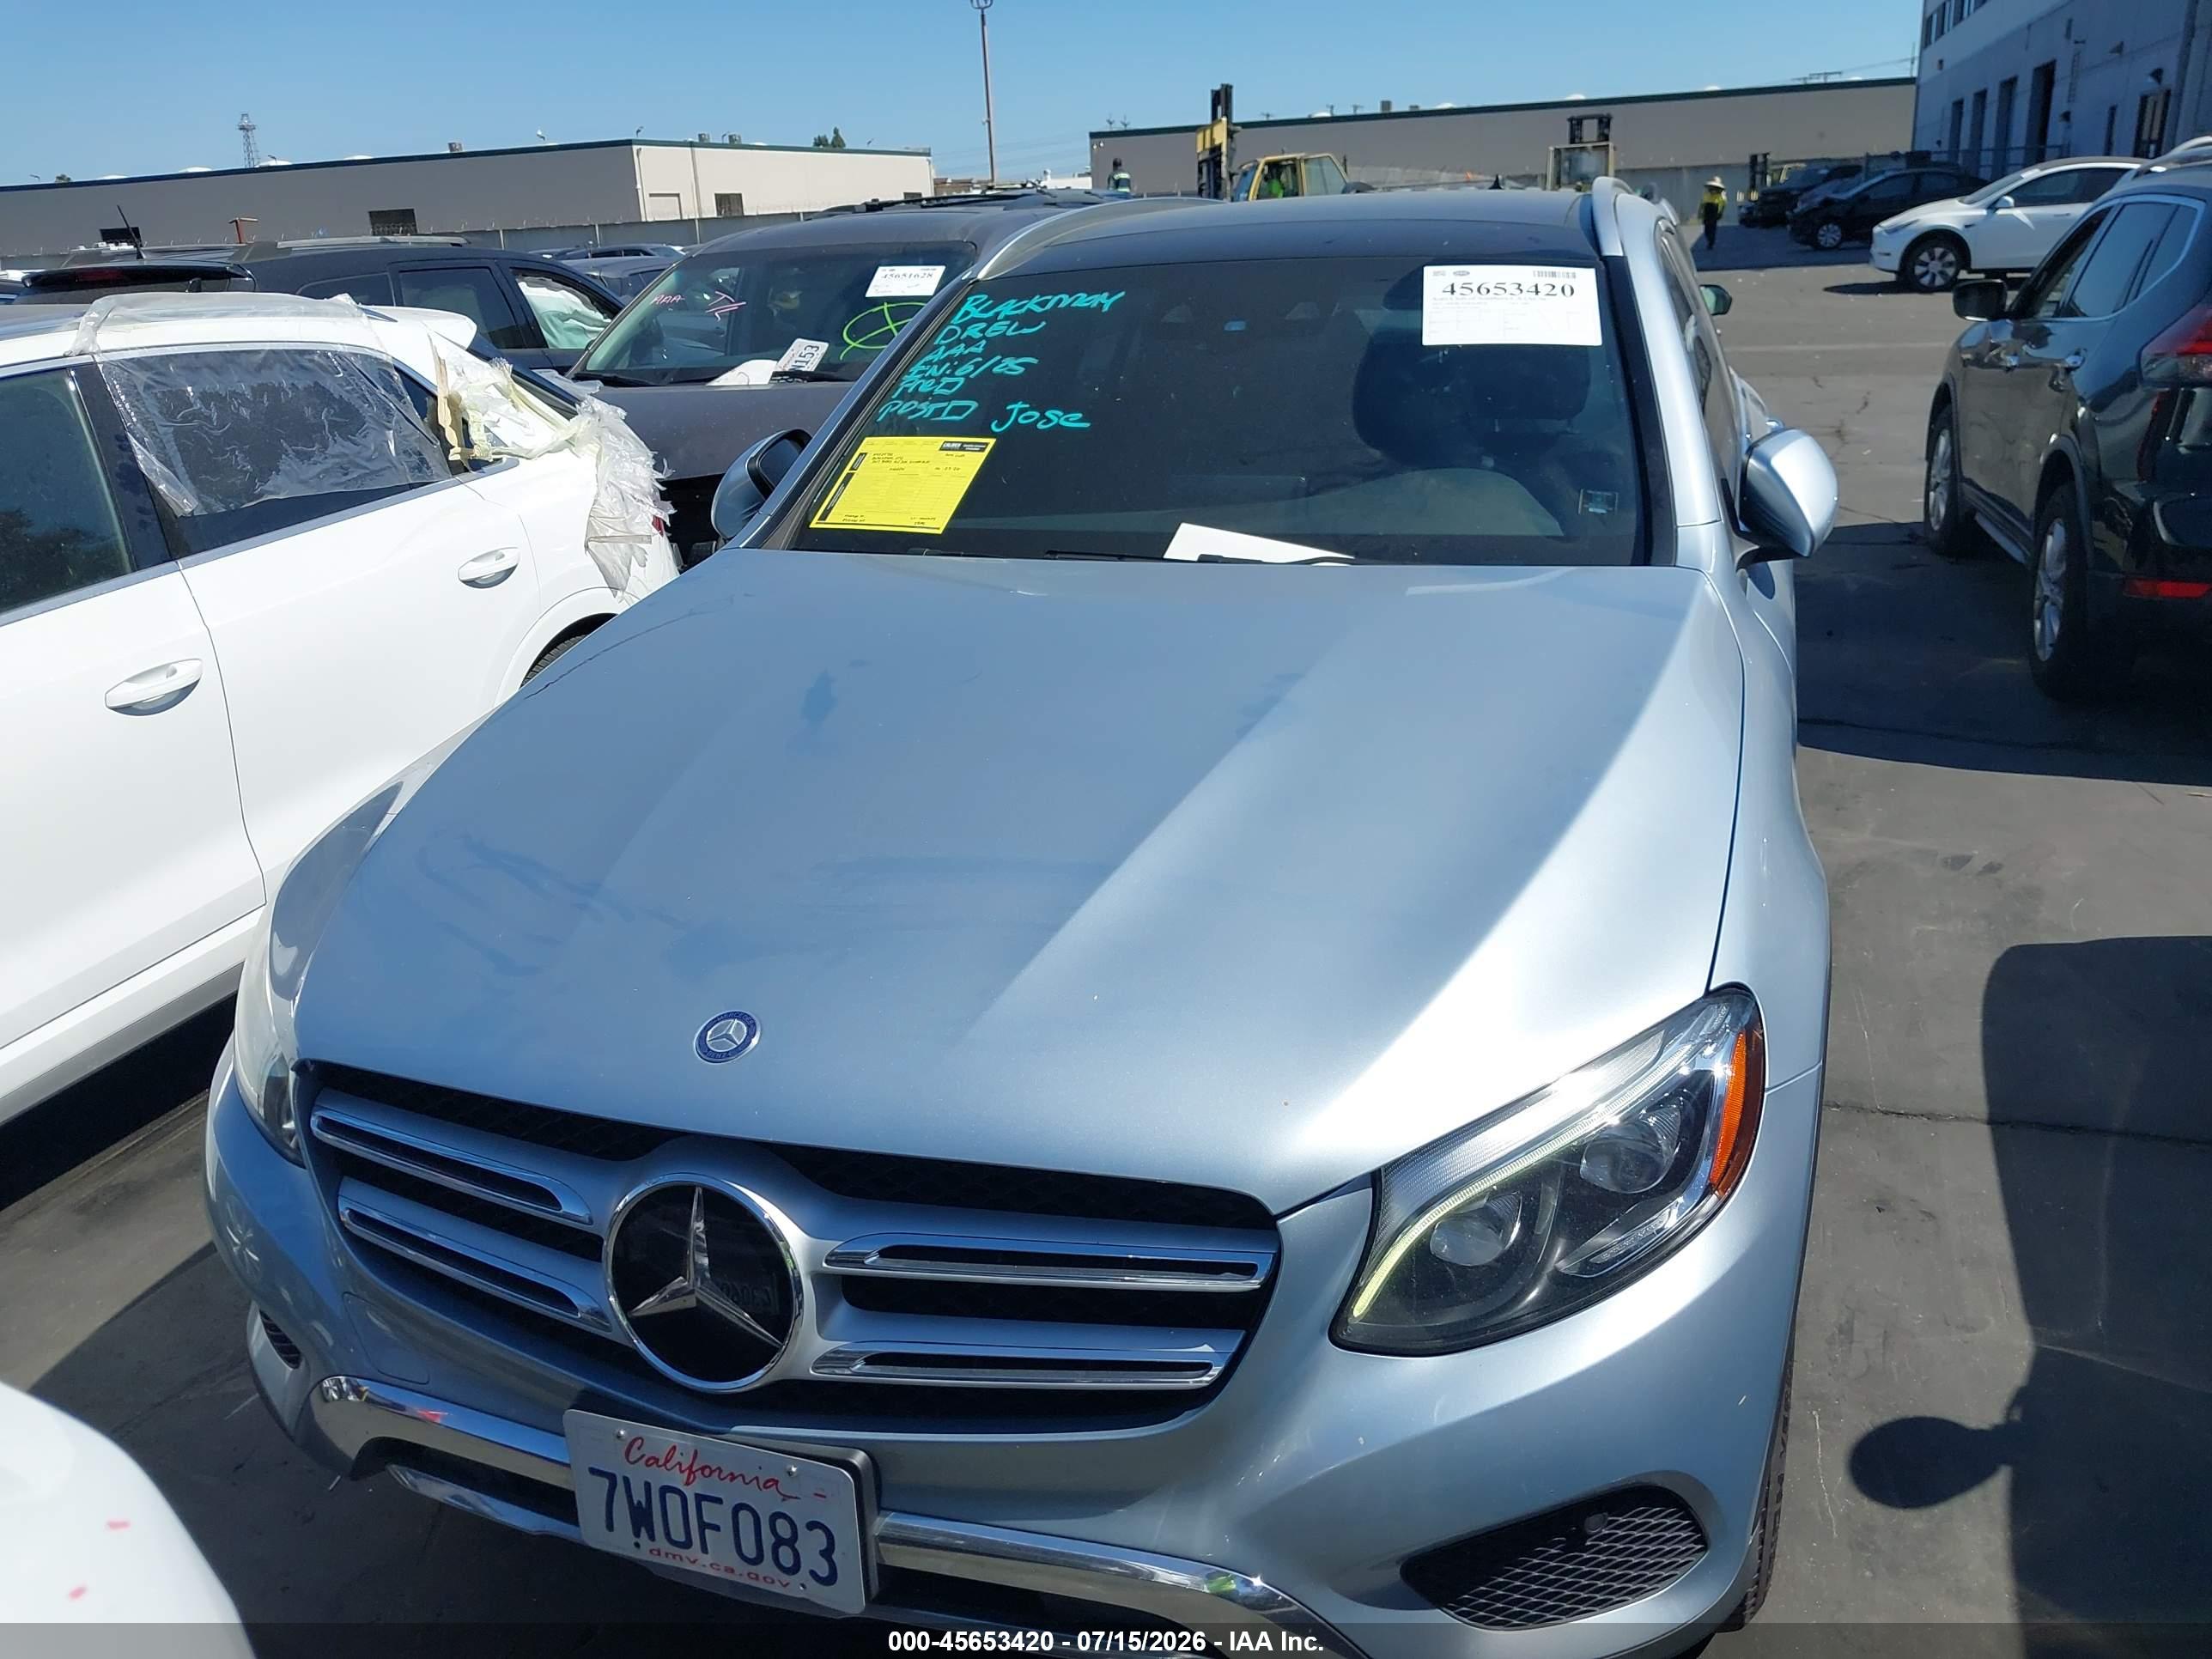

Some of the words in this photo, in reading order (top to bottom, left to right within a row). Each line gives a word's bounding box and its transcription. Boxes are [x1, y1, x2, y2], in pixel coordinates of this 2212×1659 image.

[1442, 282, 1576, 298] 45653420
[933, 320, 1048, 344] DREW
[624, 1436, 801, 1501] California
[648, 1547, 791, 1588] dmv.ca.gov
